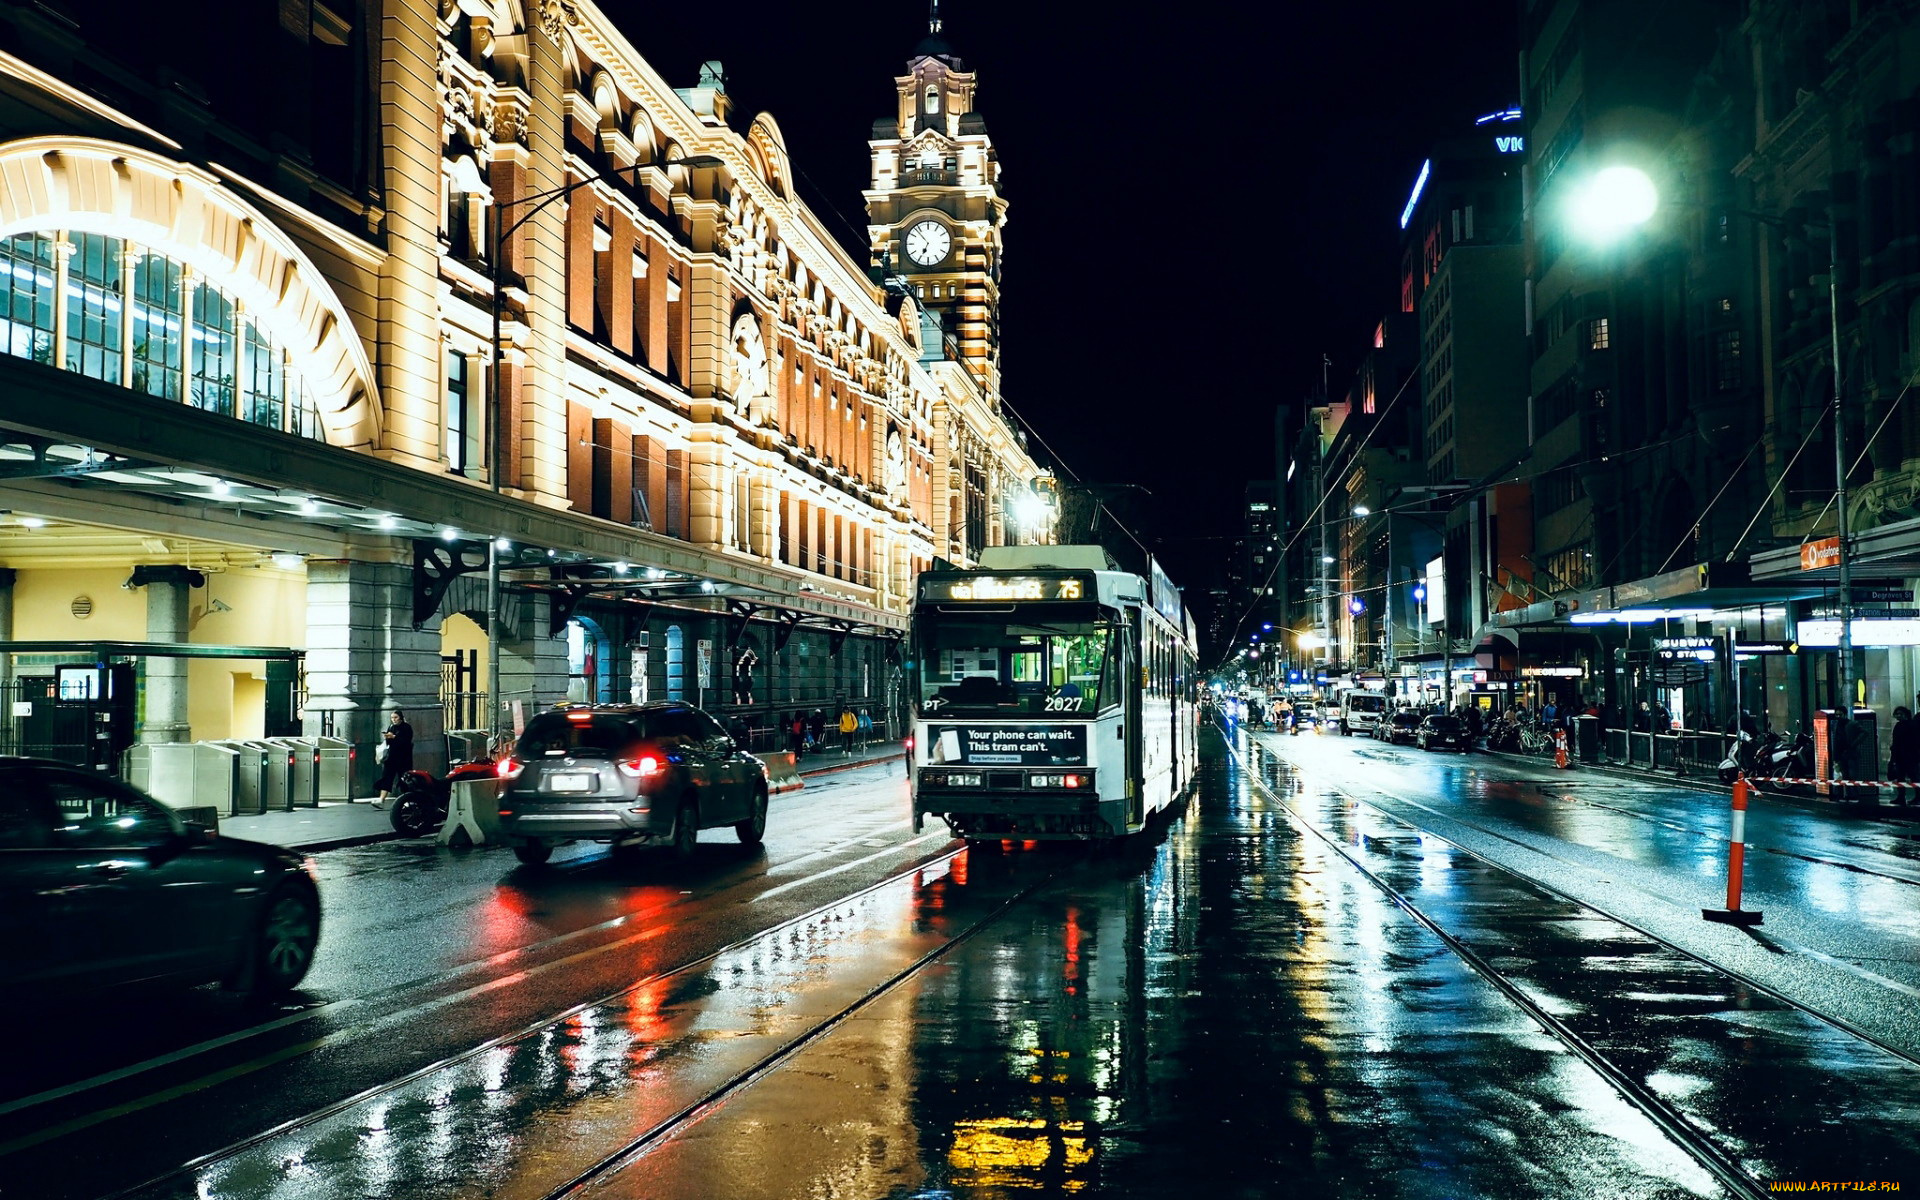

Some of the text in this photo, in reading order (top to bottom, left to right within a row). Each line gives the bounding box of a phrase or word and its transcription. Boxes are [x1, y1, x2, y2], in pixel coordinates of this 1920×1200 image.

[1816, 546, 1839, 559] vodafone
[1060, 580, 1080, 599] 75
[1872, 591, 1912, 600] Degraves St
[1858, 609, 1881, 617] STATION
[1661, 638, 1714, 648] SUBWAY
[1659, 651, 1673, 659] TO
[1044, 697, 1083, 712] 2027
[968, 729, 1075, 741] Your phone can wait.
[968, 741, 1048, 751] This tram can't.
